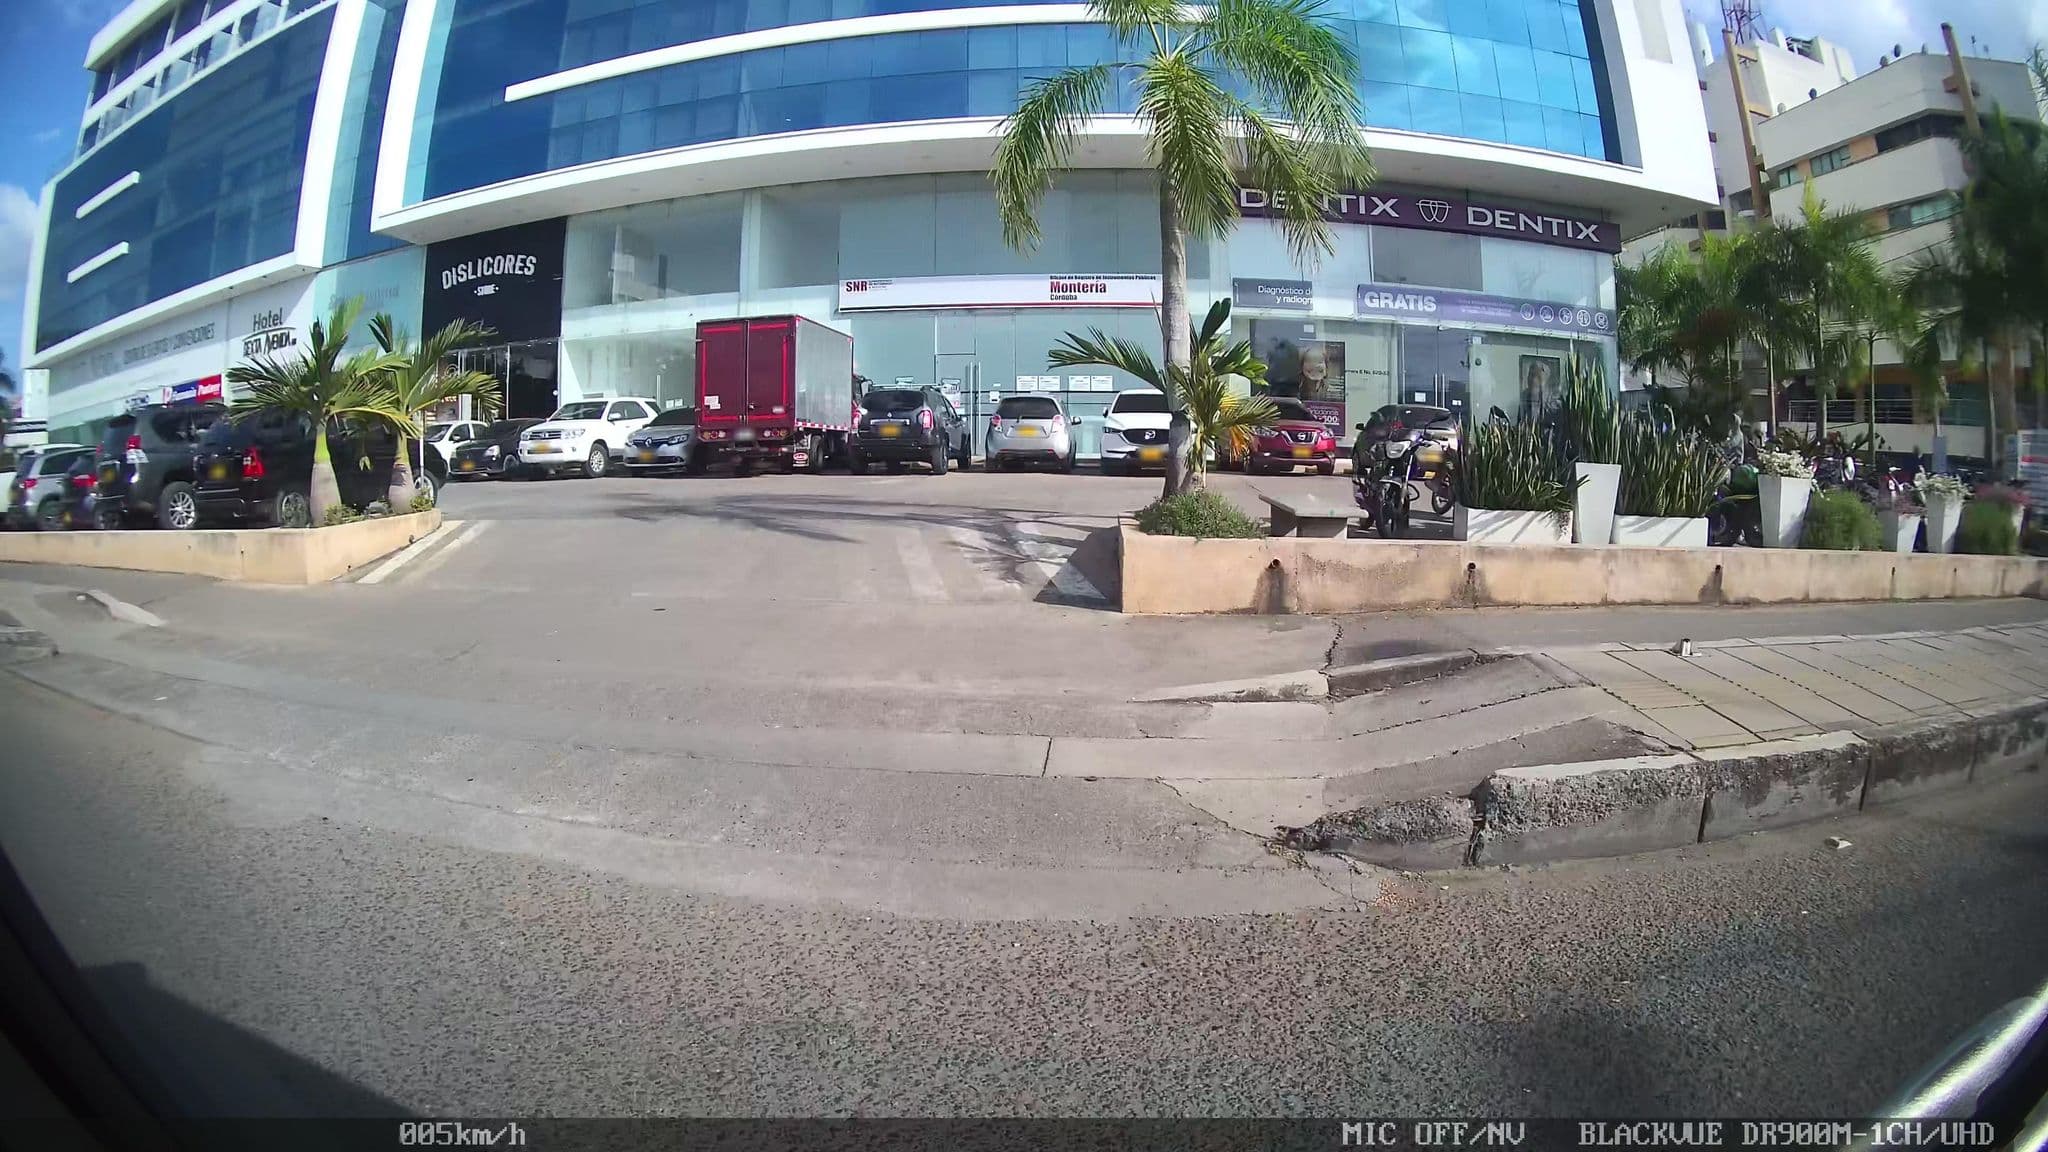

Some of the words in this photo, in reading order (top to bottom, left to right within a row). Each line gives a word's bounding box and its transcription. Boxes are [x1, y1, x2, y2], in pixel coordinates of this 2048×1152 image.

[1467, 206, 1600, 243] DENTIX
[442, 254, 537, 290] DISLICORES
[846, 280, 868, 292] SNR
[1050, 280, 1106, 293] Montería
[1258, 285, 1303, 295] Diagnóstico
[1305, 287, 1312, 295] d
[1276, 296, 1282, 304] y
[1364, 291, 1437, 312] GRATIS
[253, 307, 283, 332] Hotel
